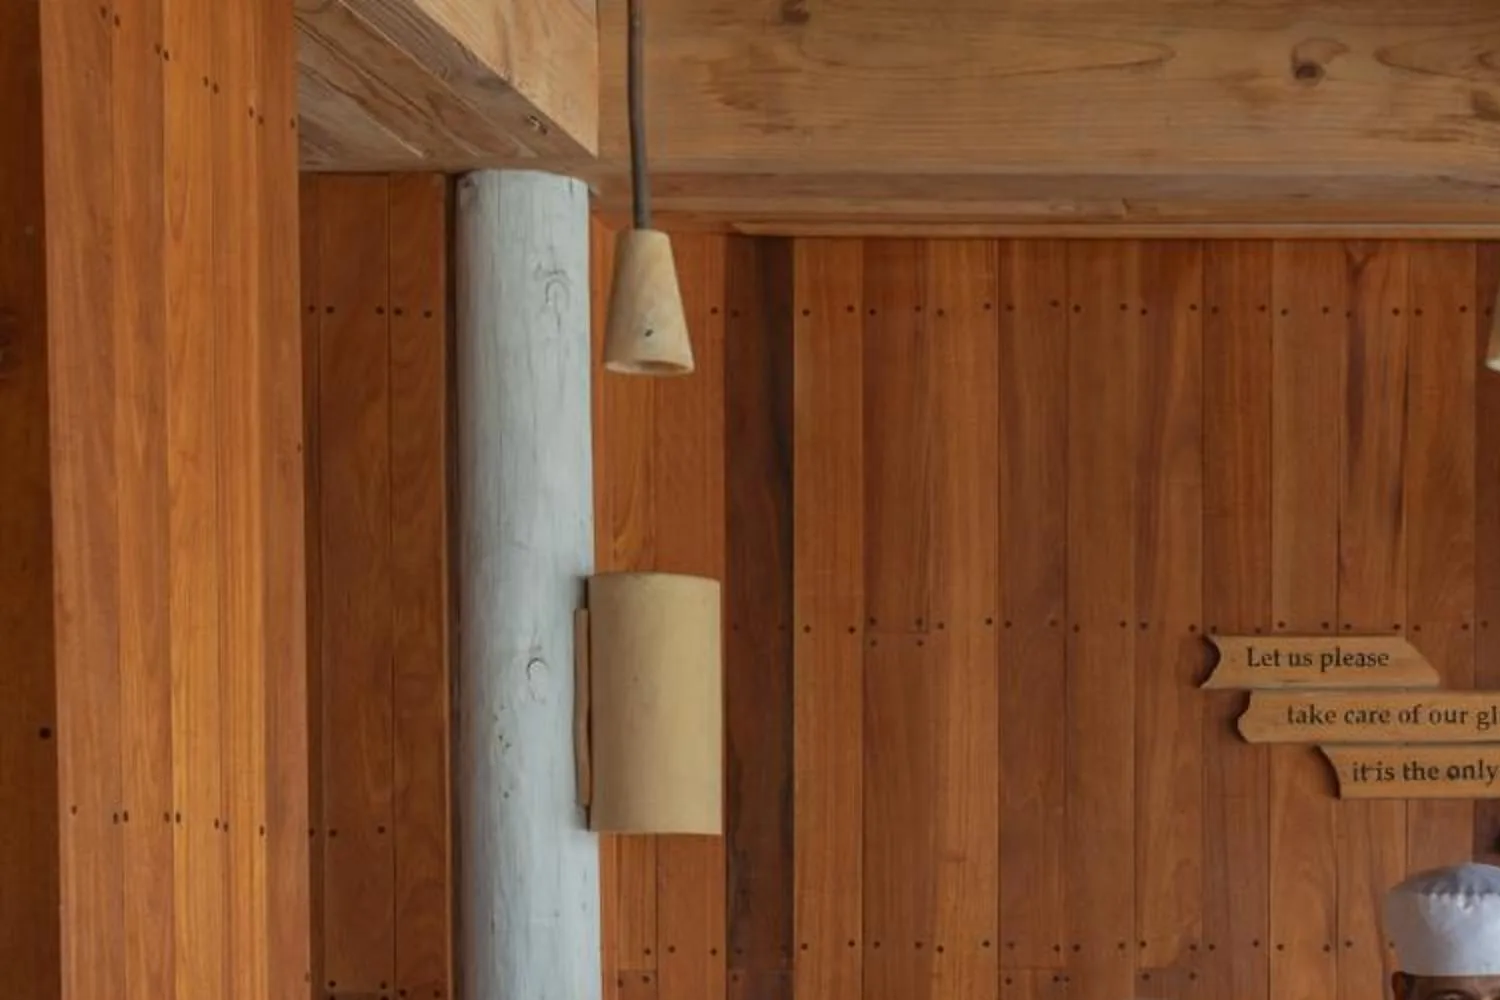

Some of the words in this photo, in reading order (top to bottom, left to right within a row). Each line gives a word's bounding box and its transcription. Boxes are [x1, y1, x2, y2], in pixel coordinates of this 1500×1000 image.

[1246, 645, 1280, 667] Let
[1288, 651, 1313, 667] us
[1320, 645, 1390, 673] please
[1287, 703, 1337, 725] take
[1344, 708, 1391, 725] care
[1398, 703, 1423, 725] of
[1429, 708, 1469, 726] our
[1375, 760, 1396, 782] is
[1403, 760, 1440, 782] the
[1446, 759, 1500, 788] only
